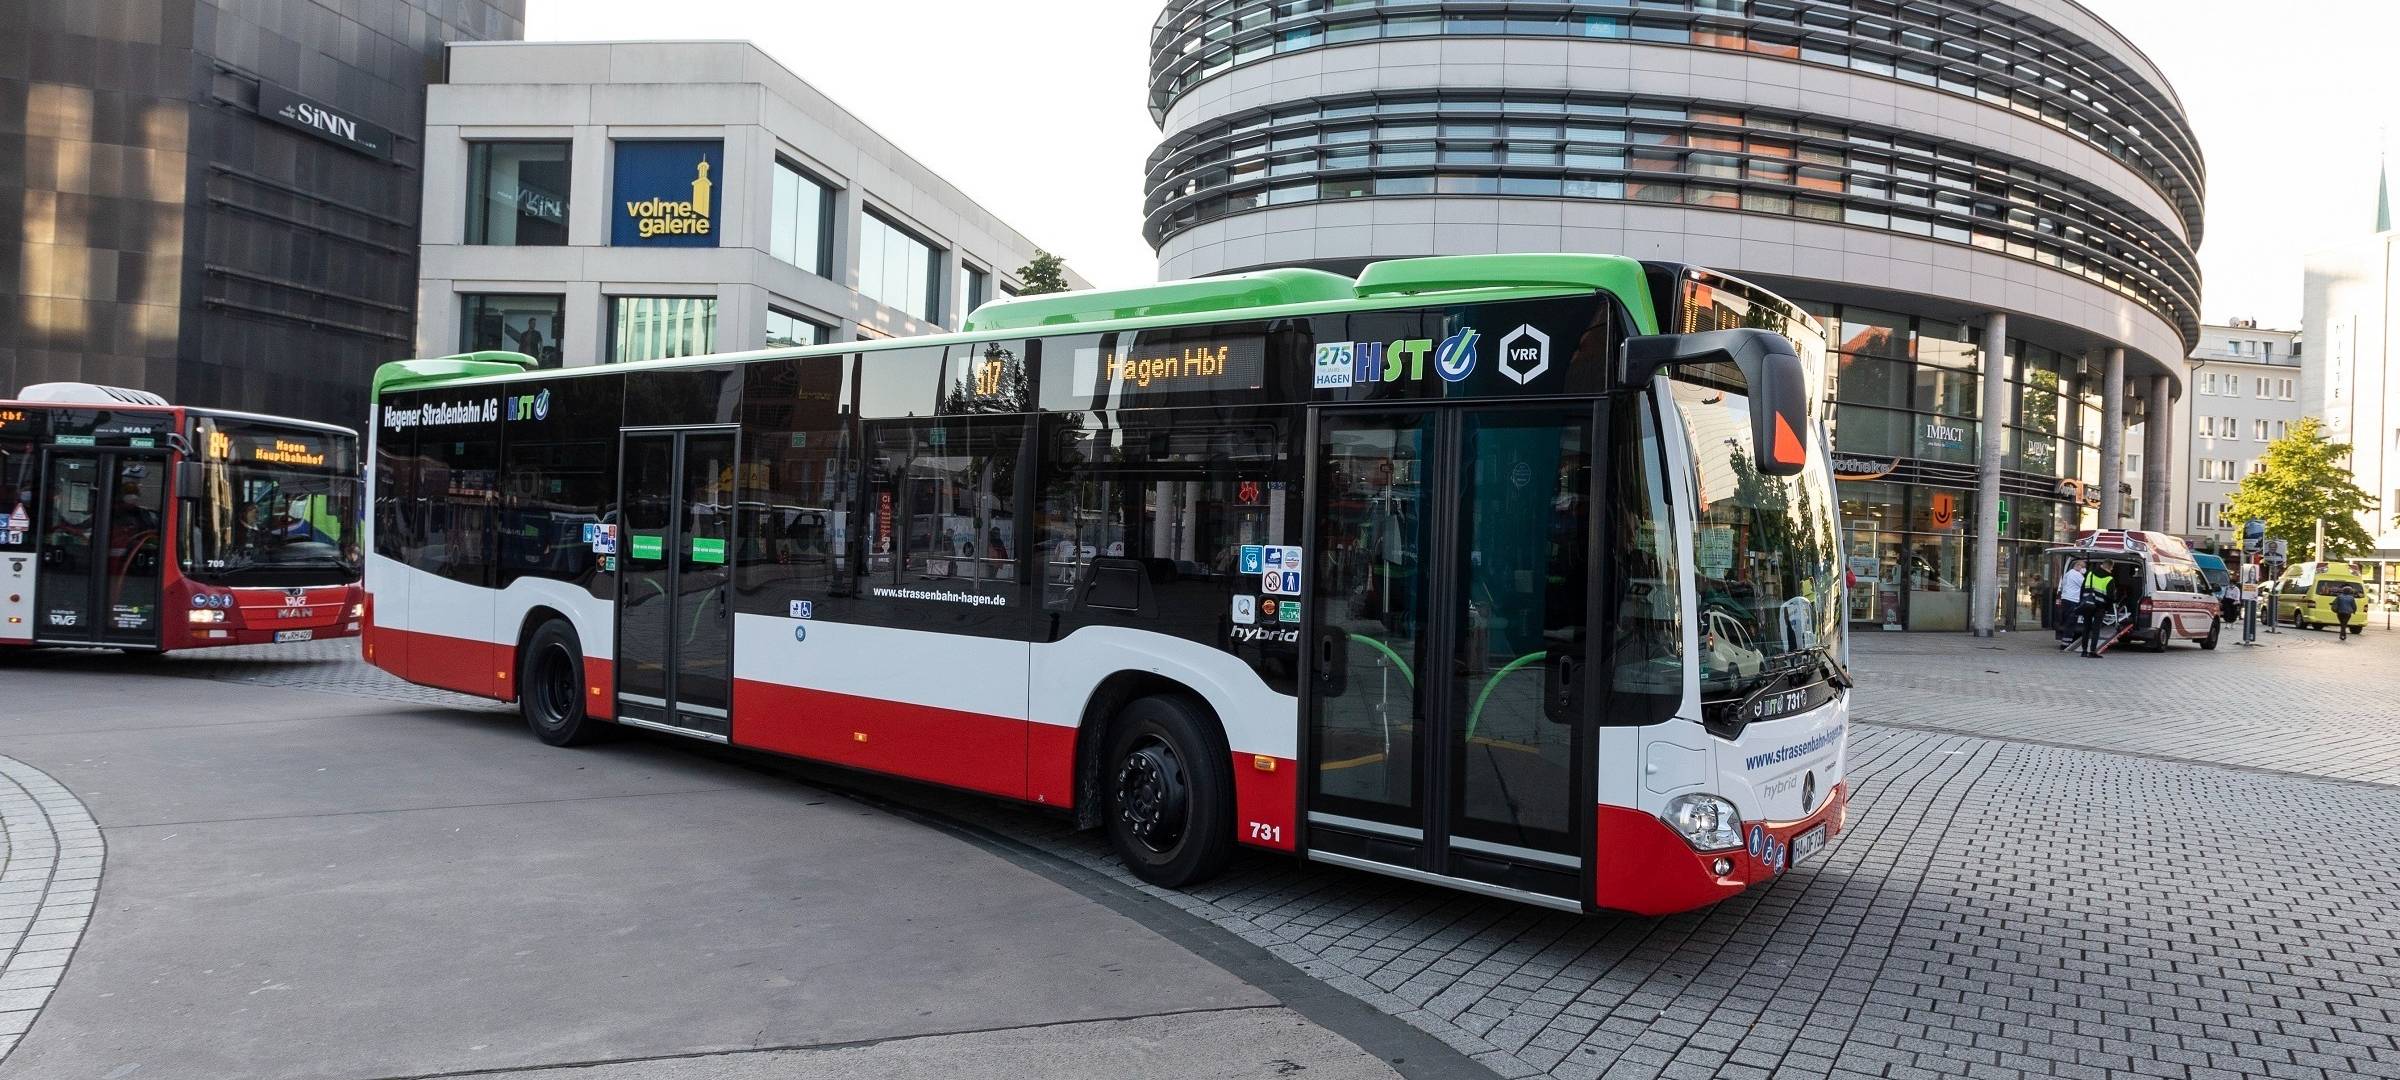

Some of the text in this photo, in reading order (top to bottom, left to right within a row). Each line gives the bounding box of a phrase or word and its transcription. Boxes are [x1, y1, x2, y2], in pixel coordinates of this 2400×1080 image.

[627, 197, 692, 217] volme
[639, 214, 710, 237] galerie
[1318, 345, 1351, 366] 275
[1355, 339, 1432, 382] HST
[1510, 348, 1538, 361] VRR
[1107, 346, 1228, 387] Hagen Hbf
[1316, 373, 1350, 384] HAGEN
[0, 411, 25, 420] tbf.
[384, 398, 498, 432] Hagener Straßenbahn AG
[508, 395, 534, 420] HST
[123, 426, 152, 434] MAN
[1926, 424, 1964, 442] IMPACT
[210, 432, 229, 458] 84
[276, 440, 306, 453] Hagen
[255, 448, 324, 464] Hauptbahnhof
[207, 560, 225, 568] 709
[873, 587, 1006, 606] www.strassenbahn-hagen.de
[277, 608, 313, 618] MAN
[1230, 625, 1299, 642] hybrid
[1787, 692, 1800, 711] 731
[1763, 775, 1797, 800] hybrid
[1250, 821, 1280, 843] 731
